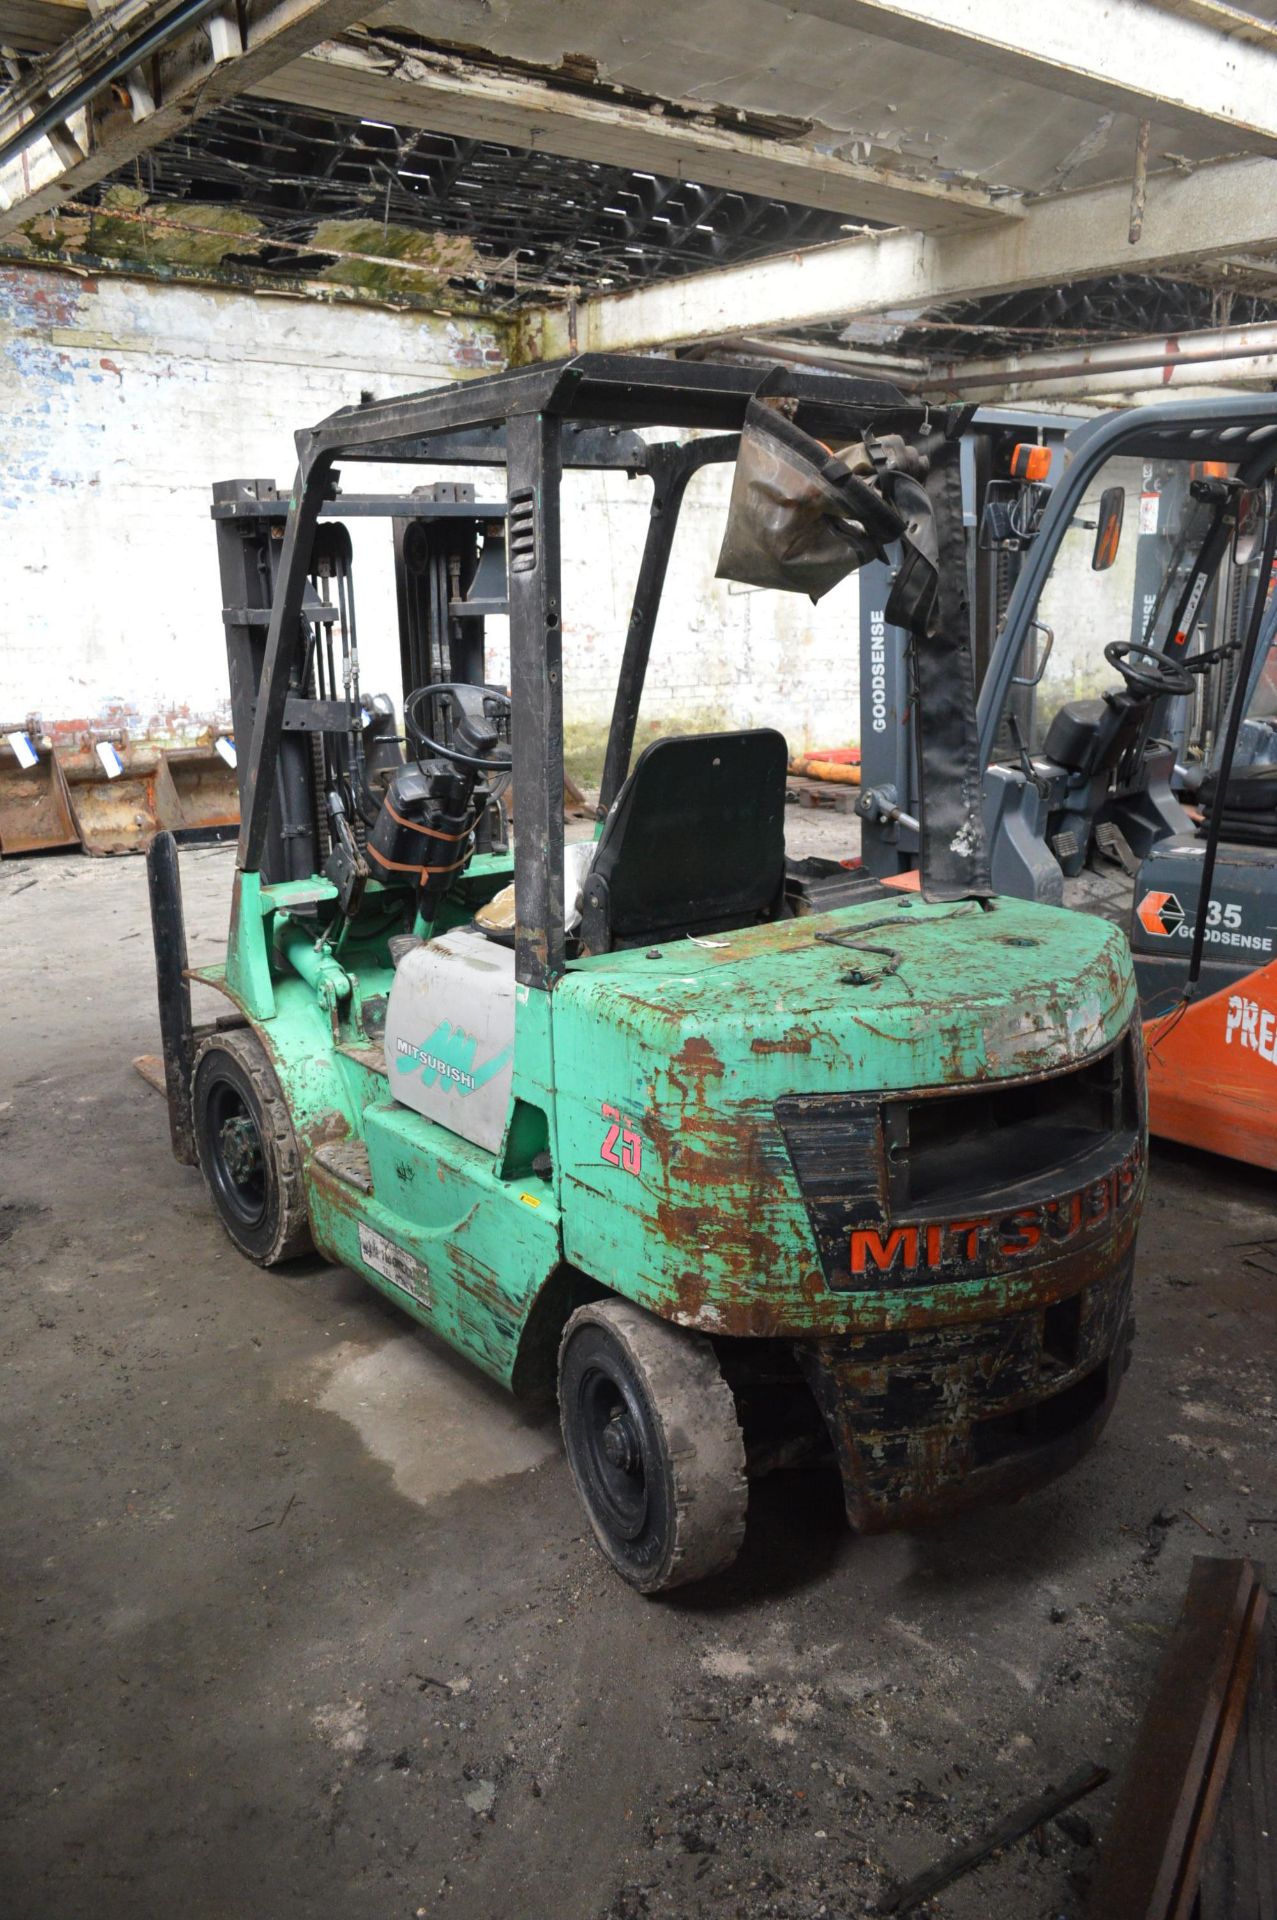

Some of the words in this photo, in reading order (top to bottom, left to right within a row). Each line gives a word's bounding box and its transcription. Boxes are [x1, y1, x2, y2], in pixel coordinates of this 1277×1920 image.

[870, 610, 887, 733] GOODSENSE
[1205, 900, 1242, 928] 35
[396, 1037, 476, 1090] MITSUBISHI
[1225, 994, 1277, 1066] PRE
[600, 1103, 642, 1176] 25
[849, 1148, 1140, 1274] MITSUBIS
